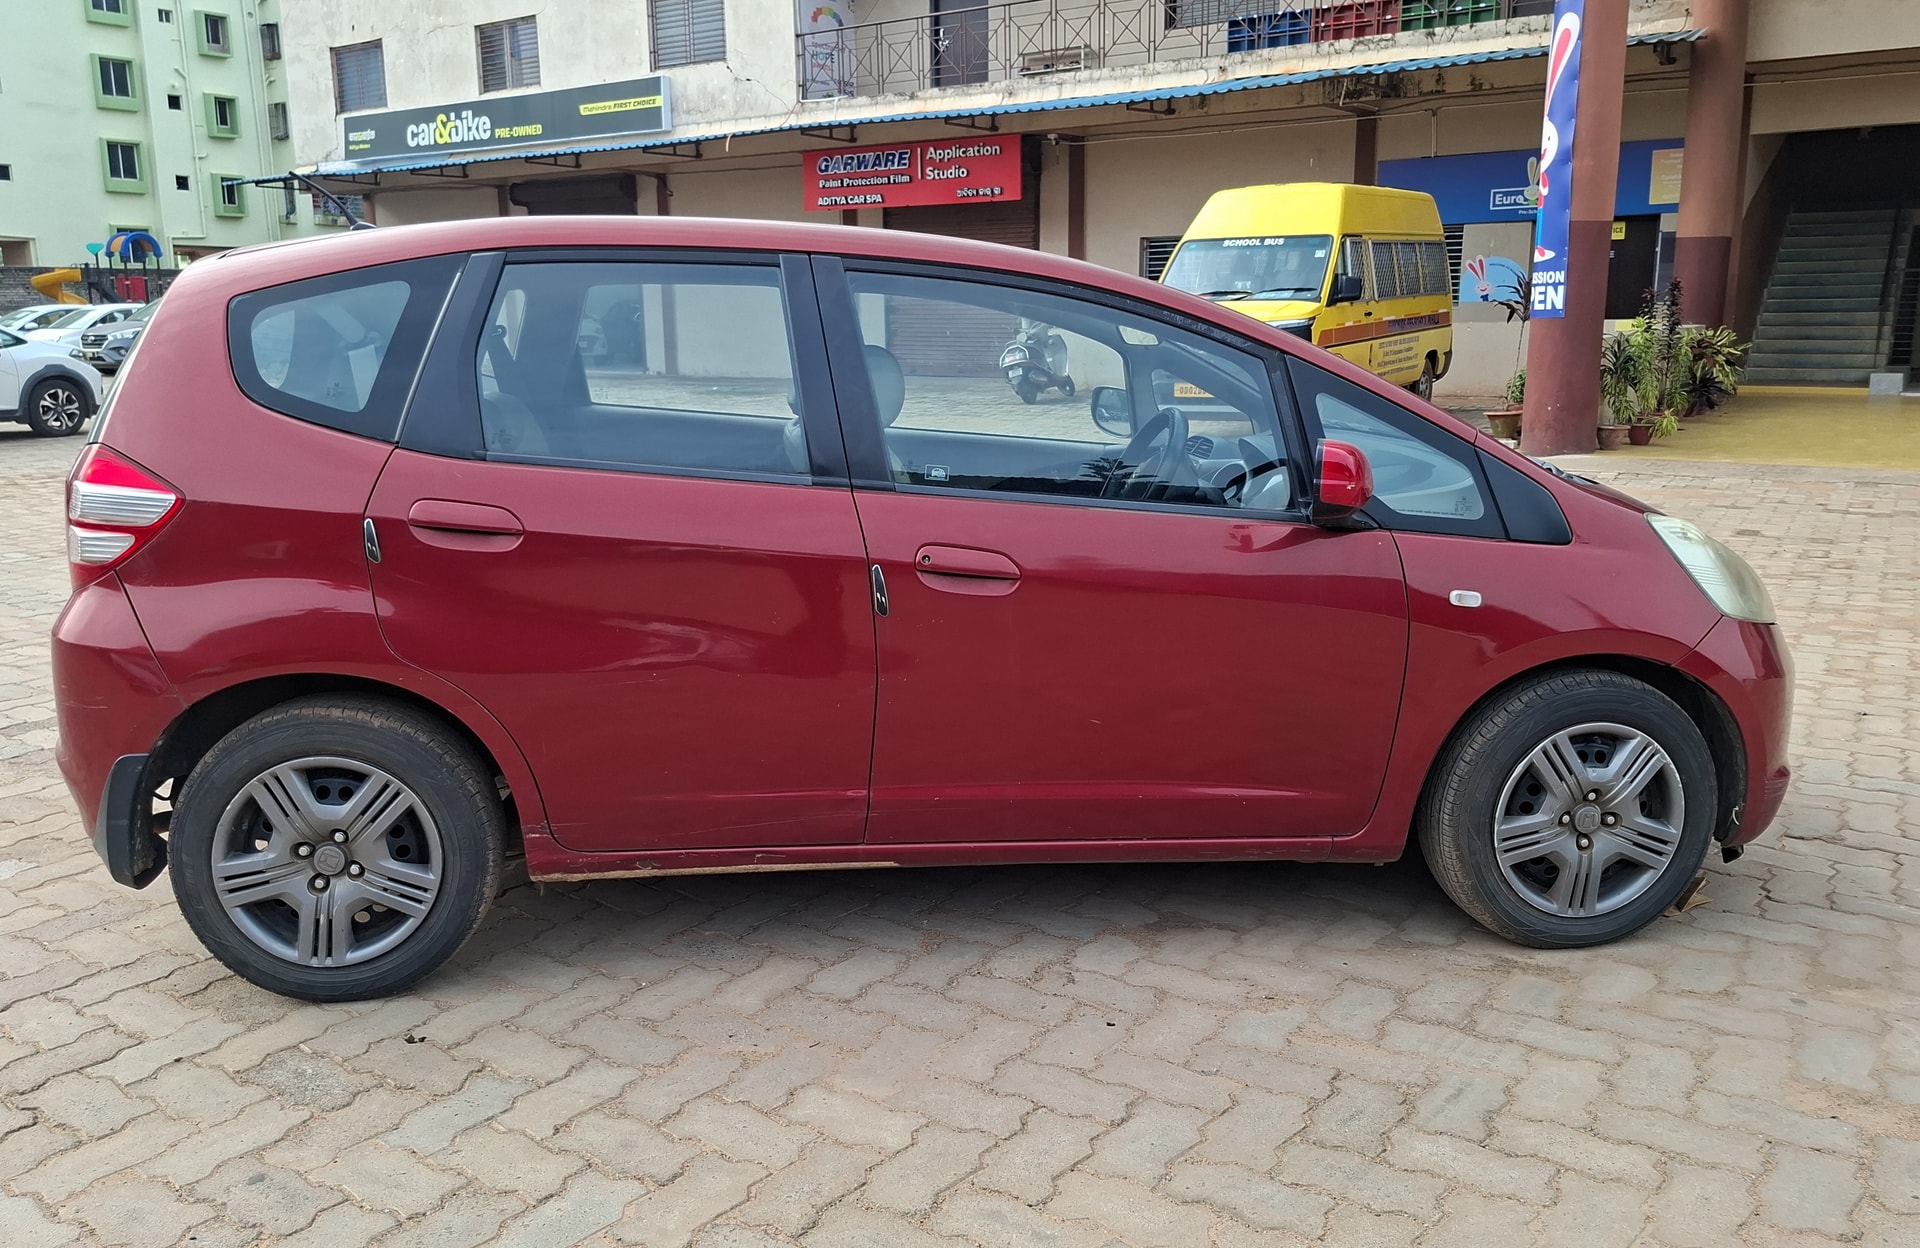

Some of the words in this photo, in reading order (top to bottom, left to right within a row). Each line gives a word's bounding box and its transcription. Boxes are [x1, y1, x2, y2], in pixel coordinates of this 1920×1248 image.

[582, 104, 612, 113] Mahindra
[613, 101, 632, 110] FIRST
[633, 98, 657, 107] CHOICE
[495, 124, 543, 138] PRE-OWNED
[926, 142, 1000, 163] Application
[817, 149, 911, 175] GARWARE
[926, 165, 968, 180] Studio
[819, 179, 841, 188] Paint
[843, 175, 888, 187] Protection
[890, 174, 910, 184] Film
[818, 195, 846, 205] ADITYA
[847, 194, 865, 204] CAR
[866, 193, 882, 203] SPA
[1222, 238, 1261, 248] SCHOOL
[1264, 238, 1284, 246] BUS
